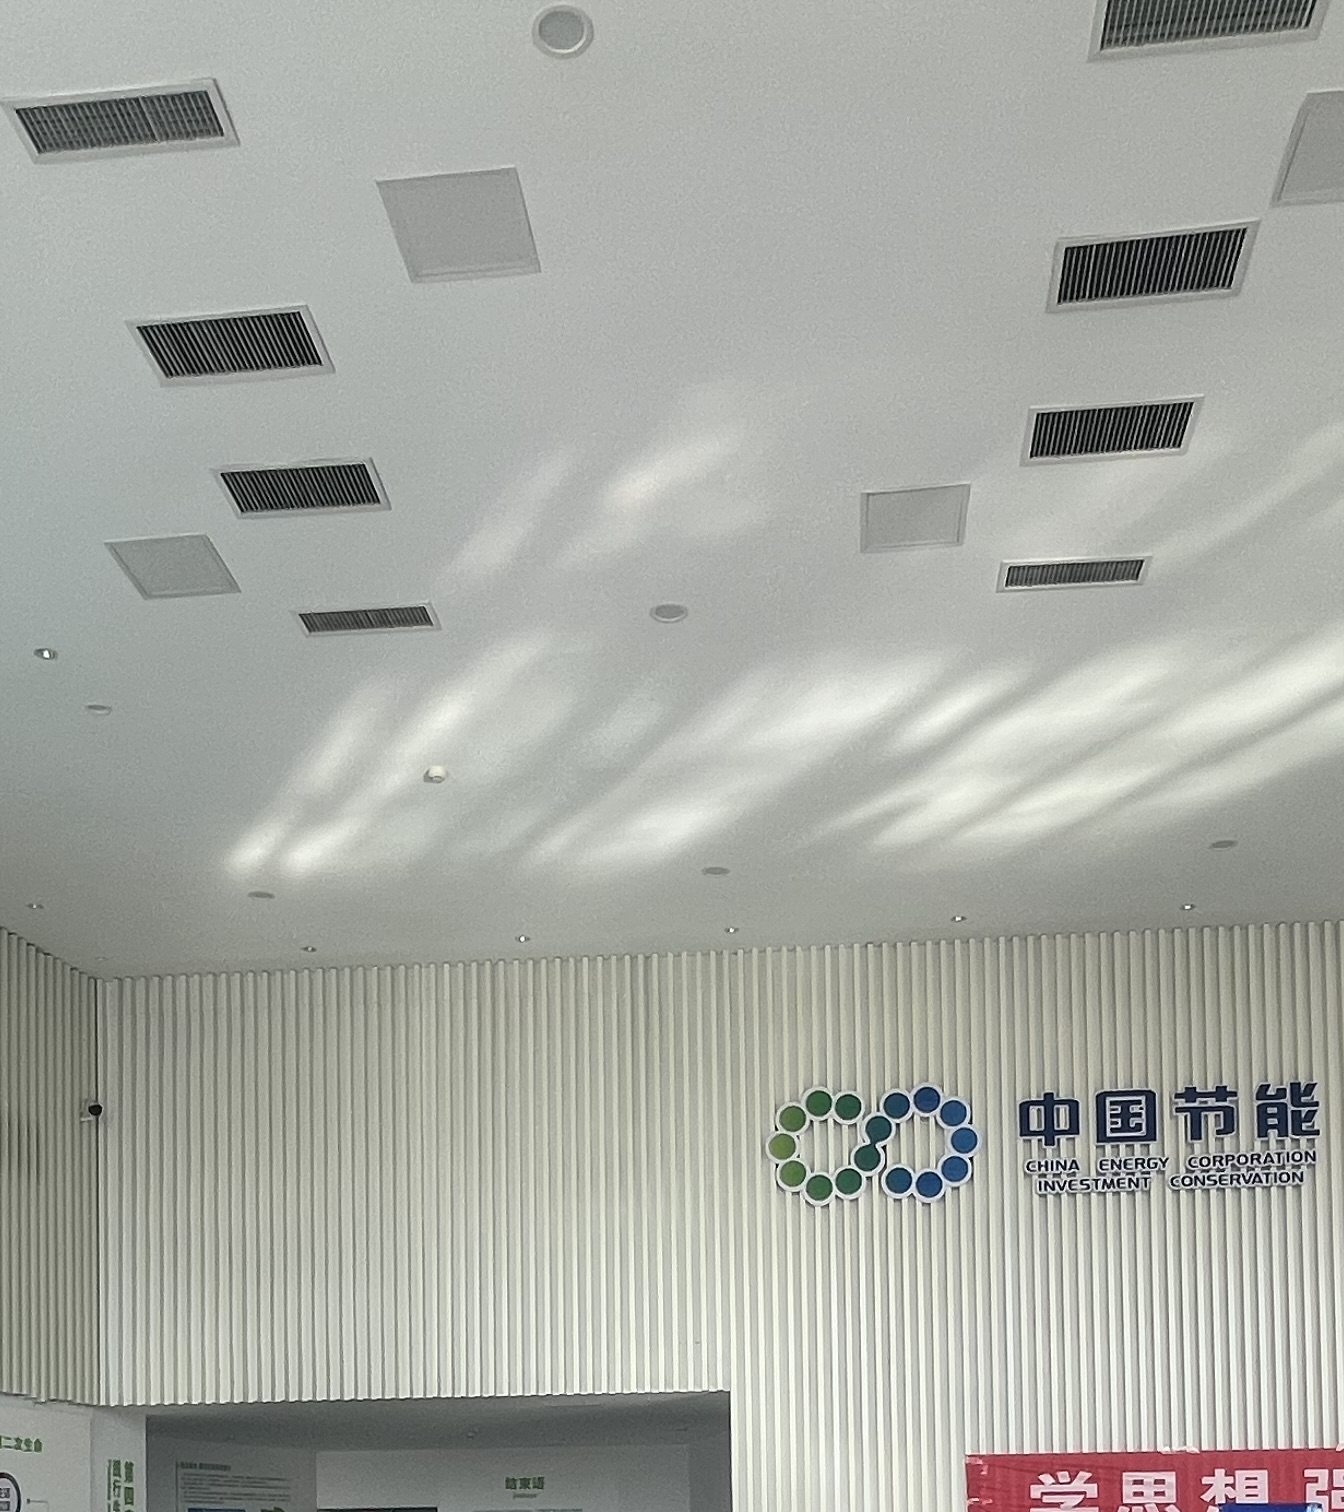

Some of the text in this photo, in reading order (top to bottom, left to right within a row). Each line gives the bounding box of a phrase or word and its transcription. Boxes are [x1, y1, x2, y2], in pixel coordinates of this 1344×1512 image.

[1018, 1081, 1321, 1147] 中国节能
[1025, 1150, 1317, 1174] CHINA ENERGY CORPORATION
[1037, 1170, 1305, 1194] INVESTMENT CONSERVATION
